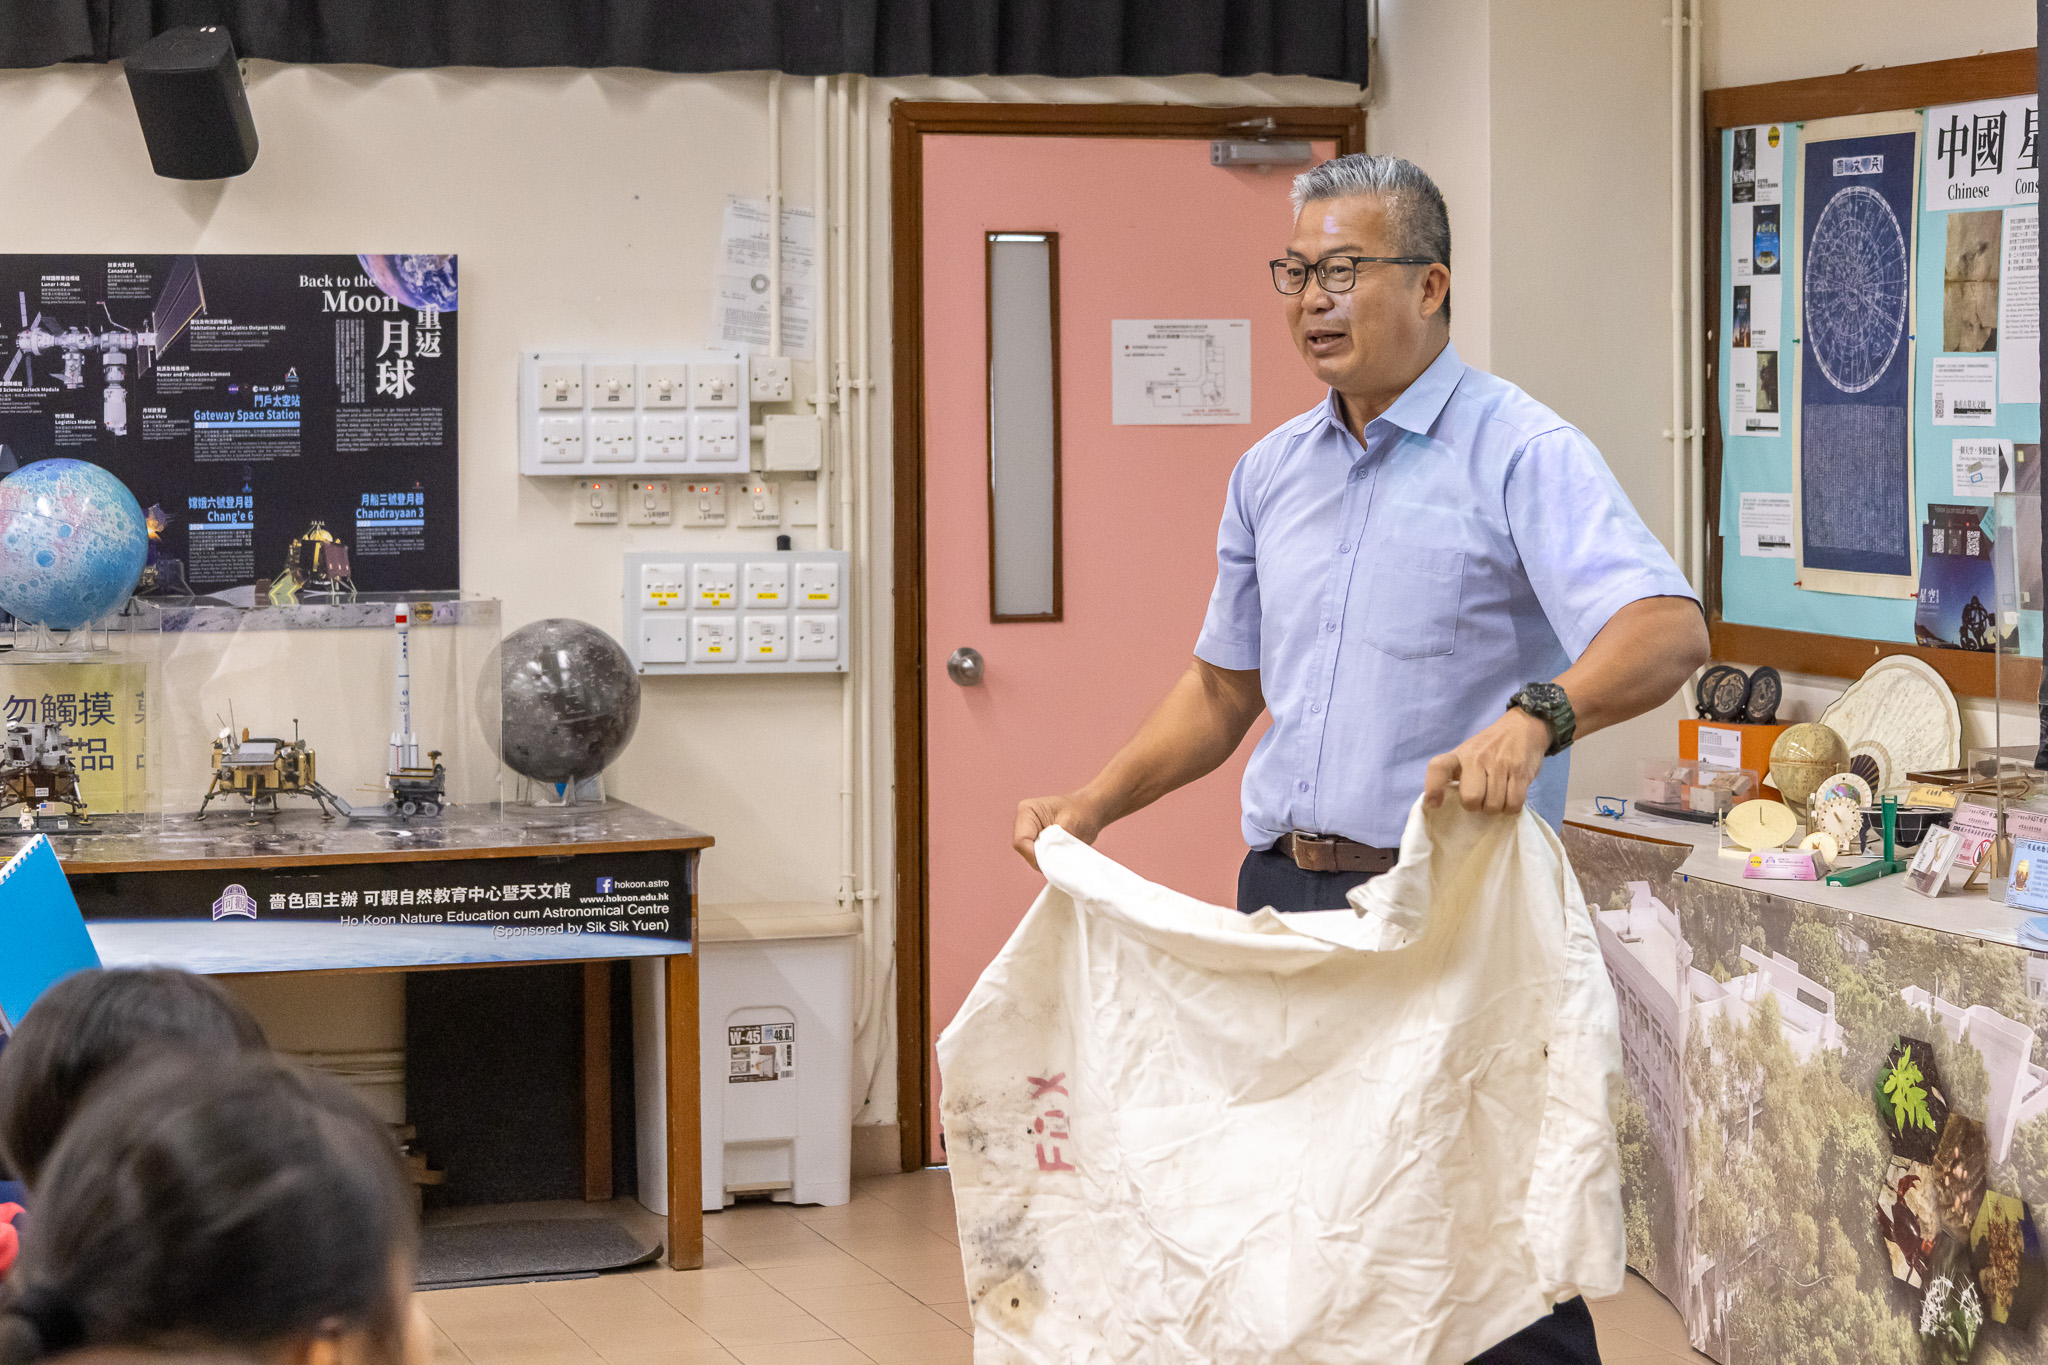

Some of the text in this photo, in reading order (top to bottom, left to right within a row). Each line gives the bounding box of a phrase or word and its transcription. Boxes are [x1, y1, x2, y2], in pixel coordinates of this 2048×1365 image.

[1938, 110, 2007, 179] 中國
[1948, 182, 1990, 200] Chinese
[299, 274, 376, 288] Back to the
[322, 290, 400, 313] Moon
[415, 303, 442, 358] 重返
[376, 319, 416, 400] 月球
[254, 394, 300, 408] 門戶太空站
[194, 408, 300, 422] Gateway Space Station
[662, 483, 667, 493] 3
[714, 486, 720, 495] 2
[188, 496, 254, 510] 嫦娥六號登月器
[361, 493, 424, 506] 月船三號登月器
[208, 510, 254, 524] Chang'e 6
[356, 507, 424, 520] Chandrayaan 3
[2, 692, 116, 727] 勿觸摸
[614, 878, 670, 889] hokoon.astro
[269, 882, 571, 910] 嗇色園主辦 可觀自然教育中心暨天文館
[580, 893, 669, 904] www.hokoon.edu.hk
[224, 896, 247, 911] 可觀
[340, 904, 670, 926] Ho Koon Nature Education cum Astronomical Centre
[492, 919, 670, 940] (Sponsored by Sik Sik Yuen)
[730, 1031, 760, 1045] W-45
